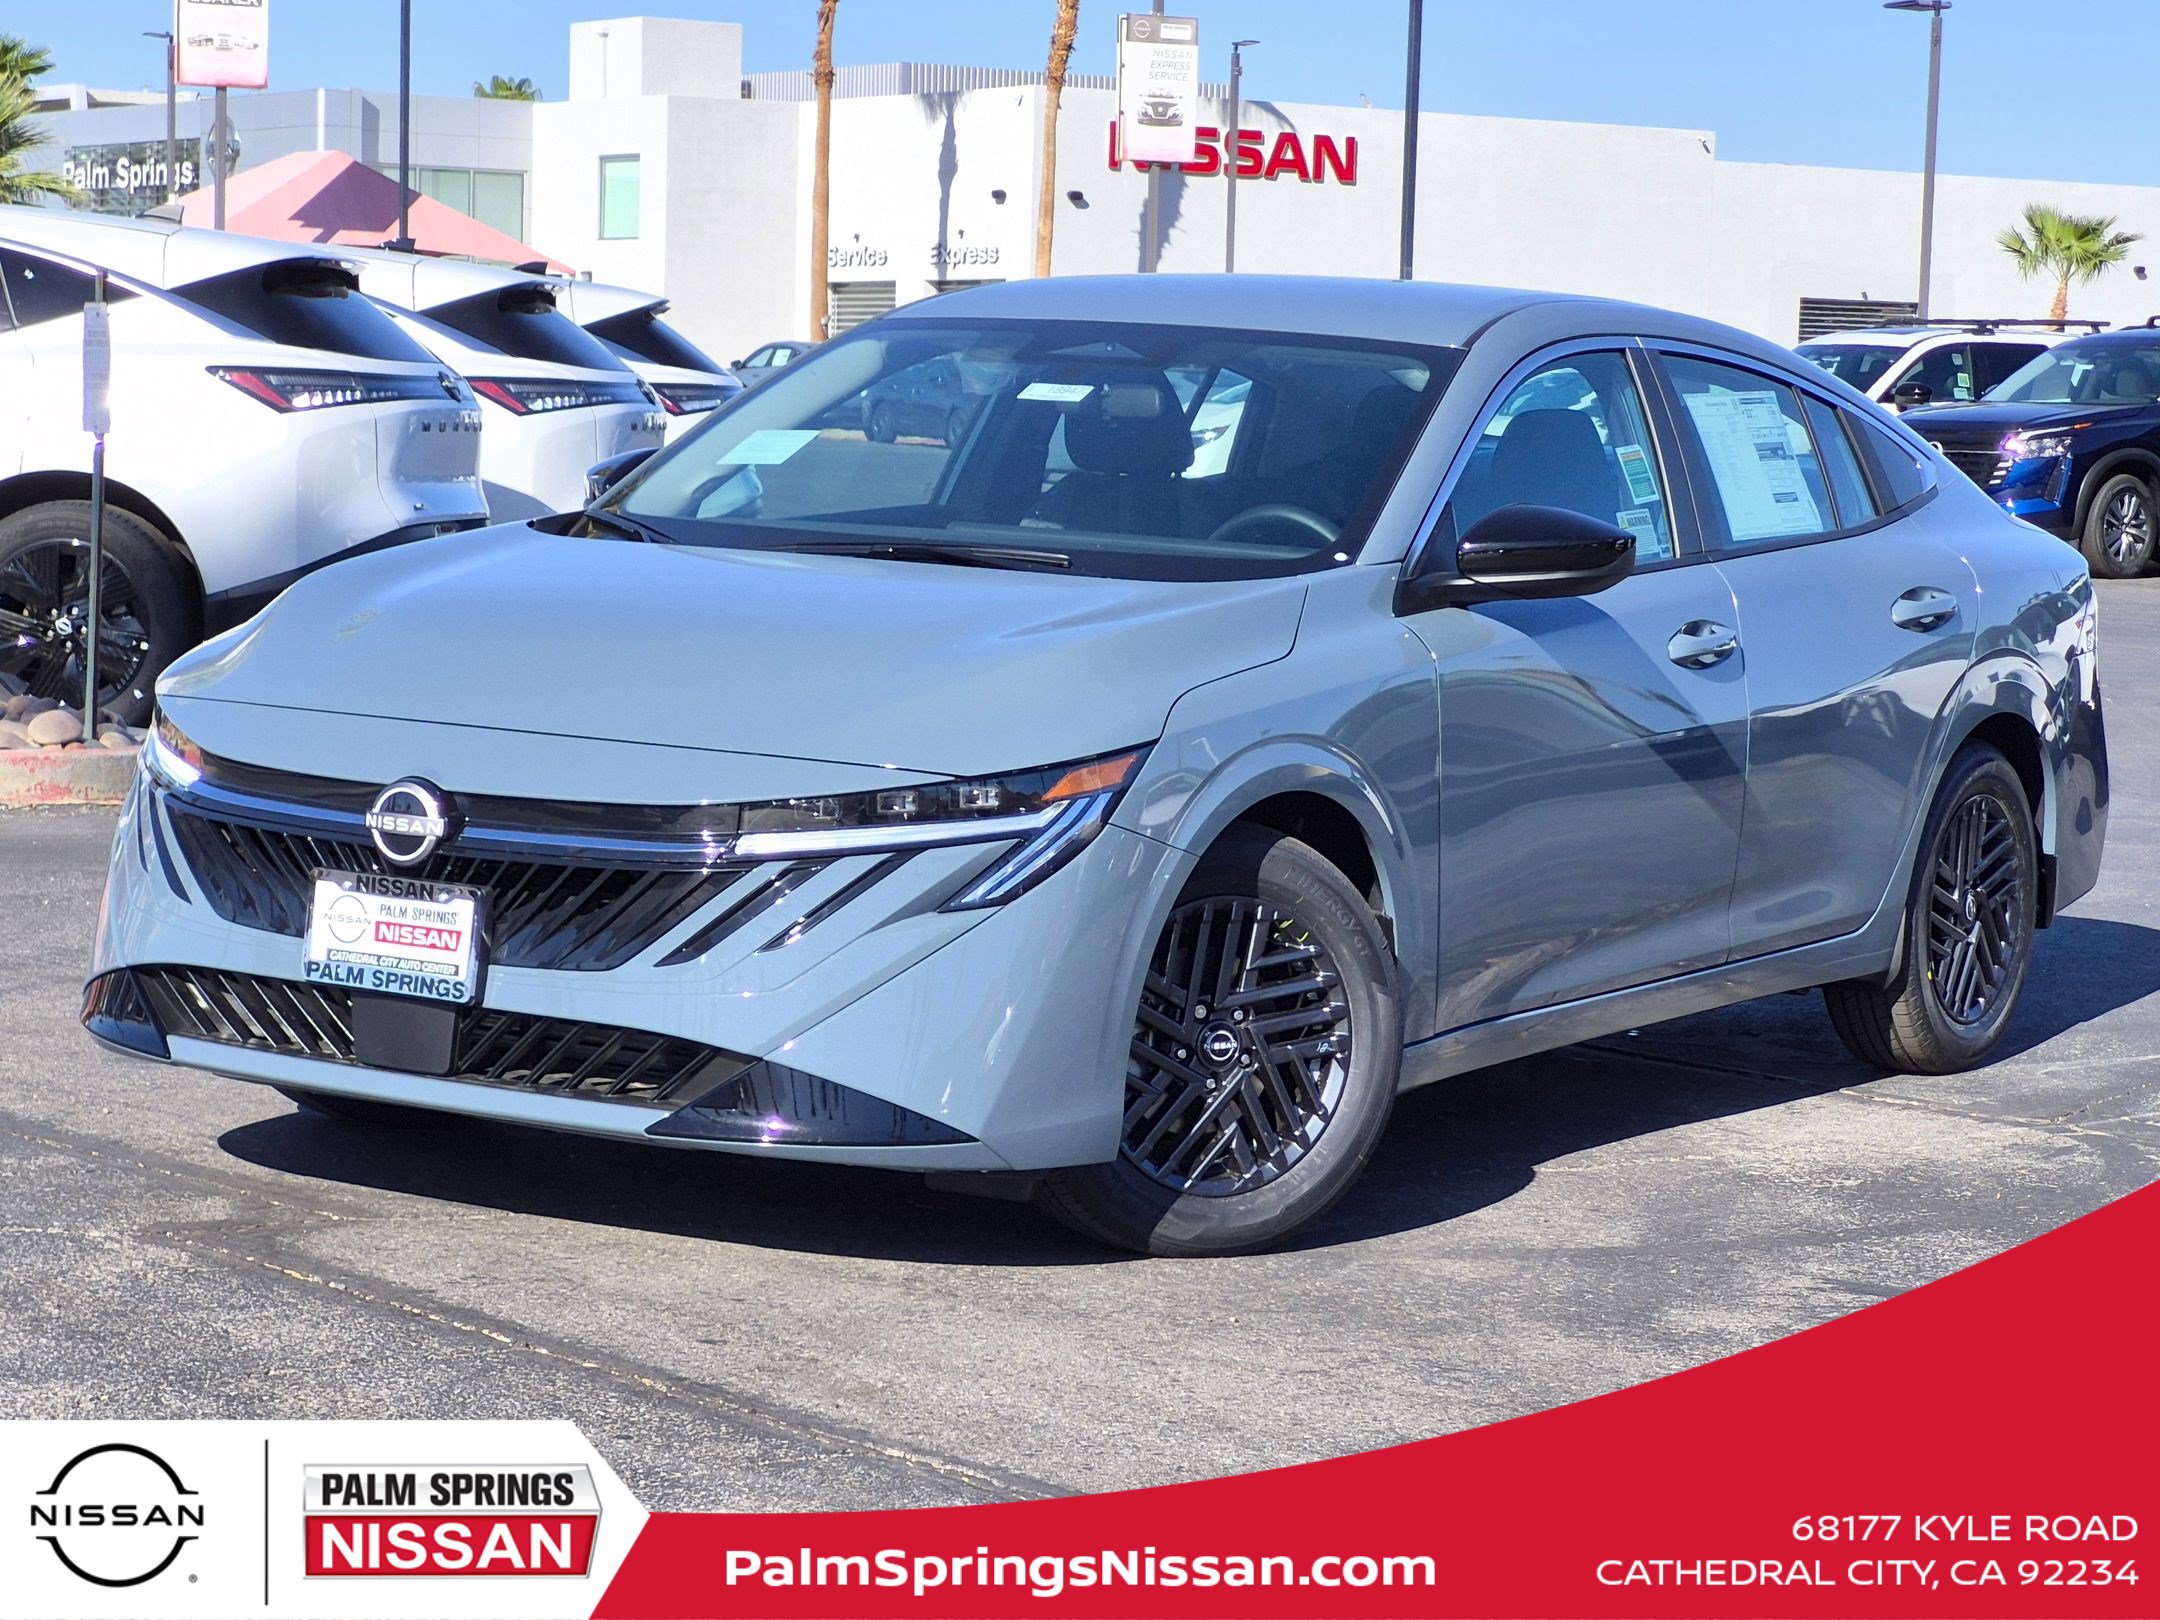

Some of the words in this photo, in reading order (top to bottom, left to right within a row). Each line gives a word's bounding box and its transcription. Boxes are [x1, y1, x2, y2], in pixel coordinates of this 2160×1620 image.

[1150, 60, 1191, 71] EXPRESS
[1152, 49, 1193, 59] NISSAN
[1148, 70, 1190, 82] SERVICE
[1109, 121, 1357, 183] SSAN
[63, 158, 110, 190] Palm
[828, 246, 888, 267] Service
[930, 244, 999, 270] Express
[365, 812, 443, 837] NISSAN
[356, 874, 434, 901] NISSAN
[323, 912, 372, 926] NISSAN
[379, 903, 408, 920] PALM
[412, 907, 457, 926] SPRINGS
[377, 922, 458, 950] NISSAN
[329, 950, 380, 965] CATHEDRAL
[380, 956, 399, 968] CITY
[398, 959, 421, 971] AUTO
[421, 962, 457, 975] CENTER
[306, 960, 365, 985] PALM
[371, 969, 466, 1000] SPRINGS
